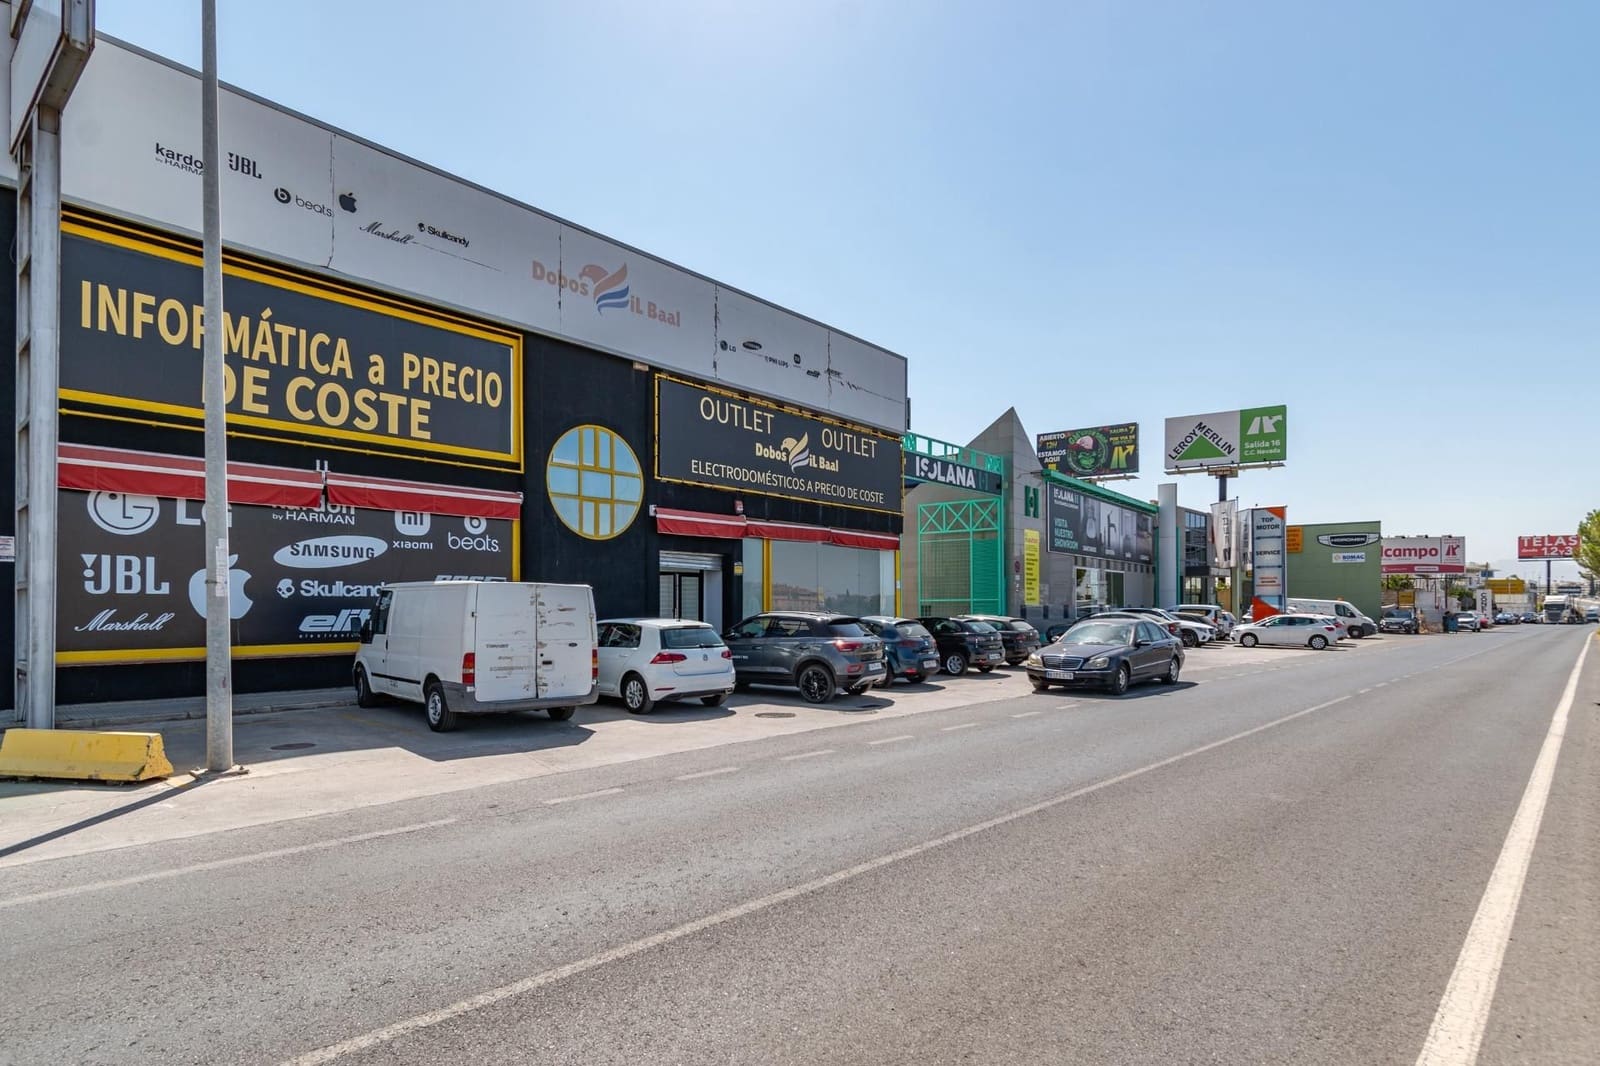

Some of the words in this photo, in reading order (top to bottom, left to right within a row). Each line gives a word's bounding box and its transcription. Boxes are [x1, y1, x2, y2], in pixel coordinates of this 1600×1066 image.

[155, 142, 203, 170] kardo
[228, 152, 262, 179] JBL
[295, 195, 332, 218] beats
[359, 221, 414, 245] Marshall
[427, 225, 470, 248] Skullcandy
[532, 260, 589, 297] Dobos
[647, 301, 681, 328] Baal
[367, 353, 385, 386] a
[402, 352, 503, 408] PRECIO
[285, 376, 432, 440] COSTE
[700, 396, 775, 434] OUTLET
[821, 428, 878, 459] OUTLET
[1040, 432, 1066, 441] ABIERTO
[1168, 428, 1198, 460] LEROY
[1195, 421, 1236, 455] MERLIN
[1244, 440, 1270, 448] Salida
[755, 442, 788, 462] Dobos
[819, 456, 839, 473] Baal
[1038, 449, 1067, 458] ESTAMOS
[691, 459, 805, 491] ELECTRODOMÉSTICOS
[806, 480, 814, 493] A
[814, 481, 846, 498] PRECIO
[847, 487, 858, 500] DE
[859, 488, 885, 505] COSTE
[285, 510, 355, 525] HARMAN
[290, 543, 376, 559] SAMSUNG
[392, 540, 433, 550] xiaomi
[447, 531, 500, 552] beats
[1381, 545, 1438, 560] lcampo
[1521, 535, 1578, 547] TELAS
[82, 554, 170, 595] JBL
[300, 580, 386, 598] Skullcand
[74, 608, 176, 632] Marshall
